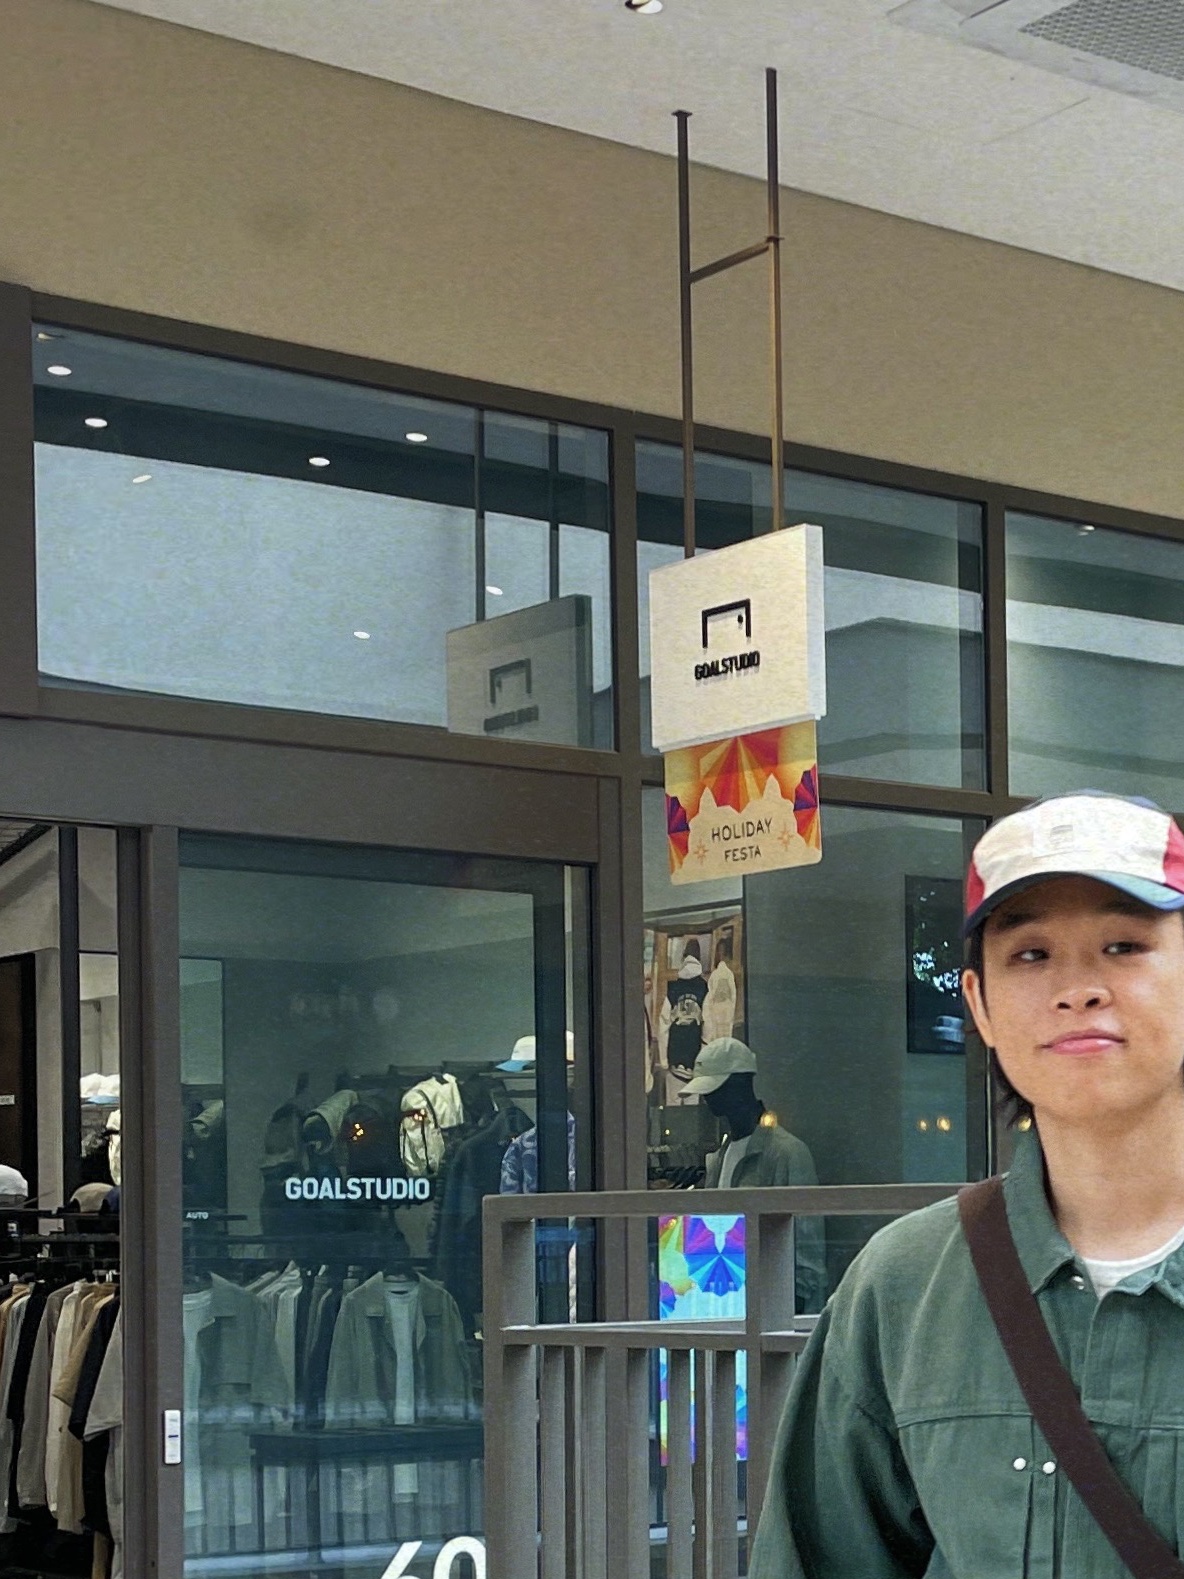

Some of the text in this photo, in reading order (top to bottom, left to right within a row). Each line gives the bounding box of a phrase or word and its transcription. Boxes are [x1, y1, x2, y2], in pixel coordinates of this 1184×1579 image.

[694, 650, 761, 681] GOALSTUDIO
[711, 817, 773, 842] HOLIDAY
[724, 846, 762, 862] FESTA
[284, 1176, 431, 1201] GOALSTUDIO
[185, 1211, 209, 1220] AUTO
